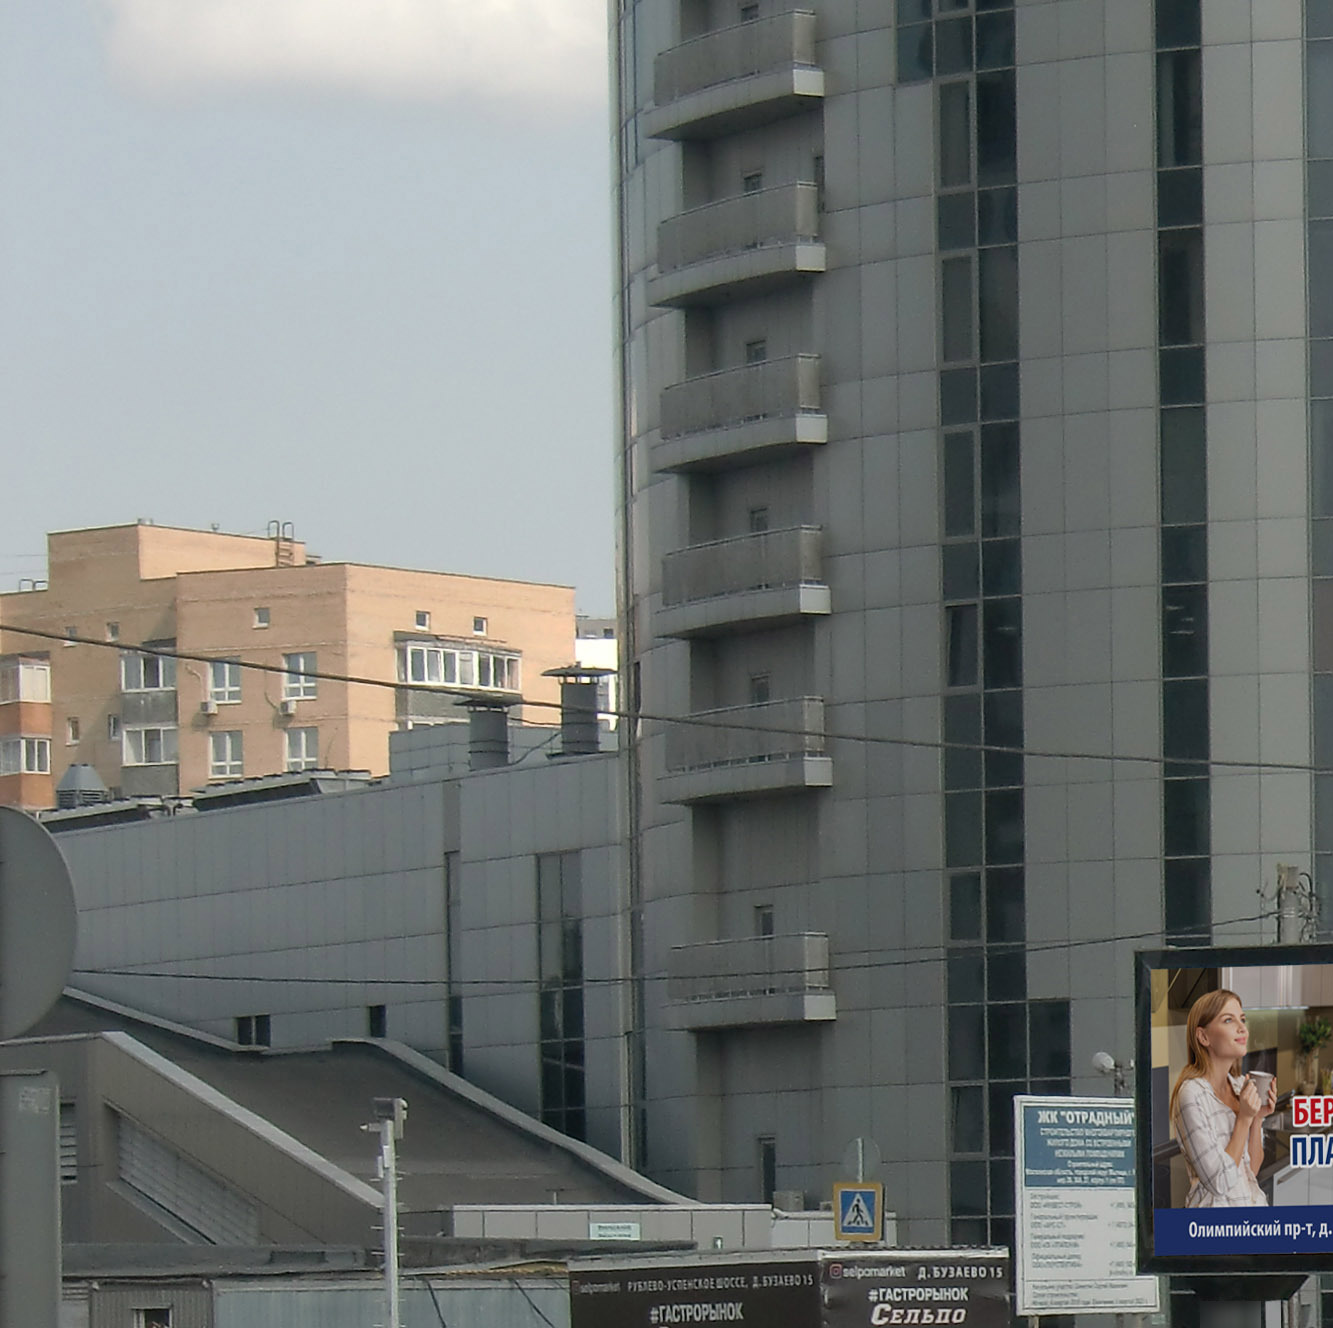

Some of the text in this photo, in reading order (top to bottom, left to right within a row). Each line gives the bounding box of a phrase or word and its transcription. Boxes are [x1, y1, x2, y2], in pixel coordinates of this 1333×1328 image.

[1037, 1110, 1059, 1124] ЖК
[1188, 1219, 1281, 1238] Олимпийский
[1318, 1221, 1333, 1239] д.
[803, 1274, 814, 1286] 15
[843, 1265, 906, 1280] selpomarket
[989, 1266, 1003, 1279] 15
[868, 1287, 969, 1302] #ГАСТРОРЫНОК
[650, 1301, 744, 1324] #ГАСТРОРЫНОК
